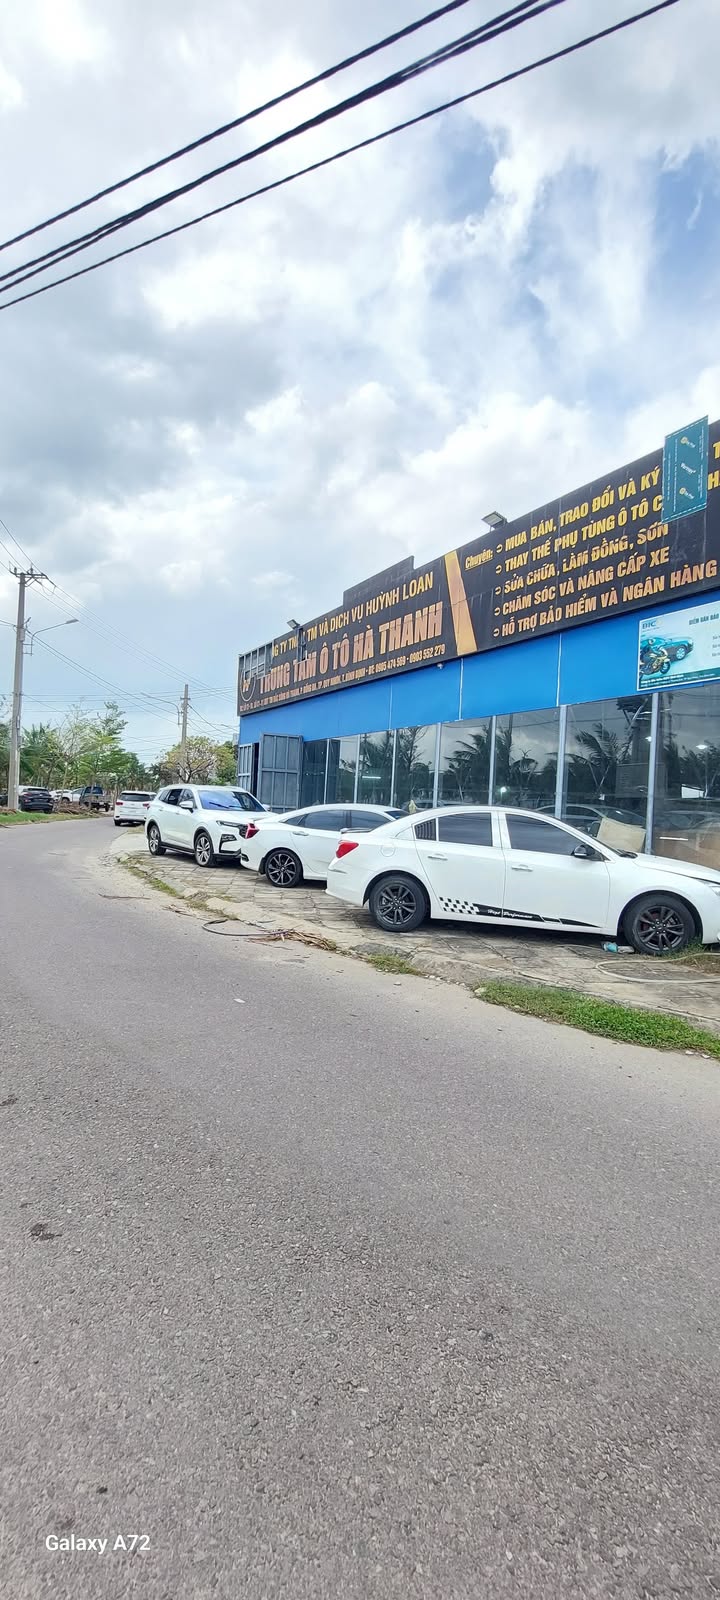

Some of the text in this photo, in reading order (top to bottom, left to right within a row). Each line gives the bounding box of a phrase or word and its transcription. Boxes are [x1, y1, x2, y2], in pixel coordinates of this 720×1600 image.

[505, 534, 527, 551] MUA
[531, 518, 557, 540] BÁN,
[560, 502, 589, 527] TRAO
[591, 485, 615, 513] ĐỔI
[618, 478, 636, 500] VÀ
[640, 466, 661, 487] KÝ
[505, 550, 529, 573] THAY
[531, 537, 552, 560] THẾ
[554, 530, 578, 549] PHỤ
[582, 516, 615, 542] TÙNG
[618, 507, 627, 526] Ô
[631, 498, 649, 520] TÔ
[319, 617, 328, 636] VÀ
[330, 611, 349, 633] DỊCH
[351, 604, 364, 623] VỤ
[366, 587, 399, 616] HUỲNH
[402, 571, 433, 600] LOAN
[502, 546, 670, 615] CHĂM SÓC VÀ NÂNG CẤP XE
[502, 559, 717, 637] HỖ TRỢ BẢO HIỂM VÀ NGÂN HÀNG
[504, 573, 524, 594] SỬA
[563, 550, 588, 572] LÀM
[320, 642, 328, 674] Ô
[332, 633, 350, 670] TÔ
[353, 624, 374, 663] HÀ
[379, 601, 443, 655] THANH
